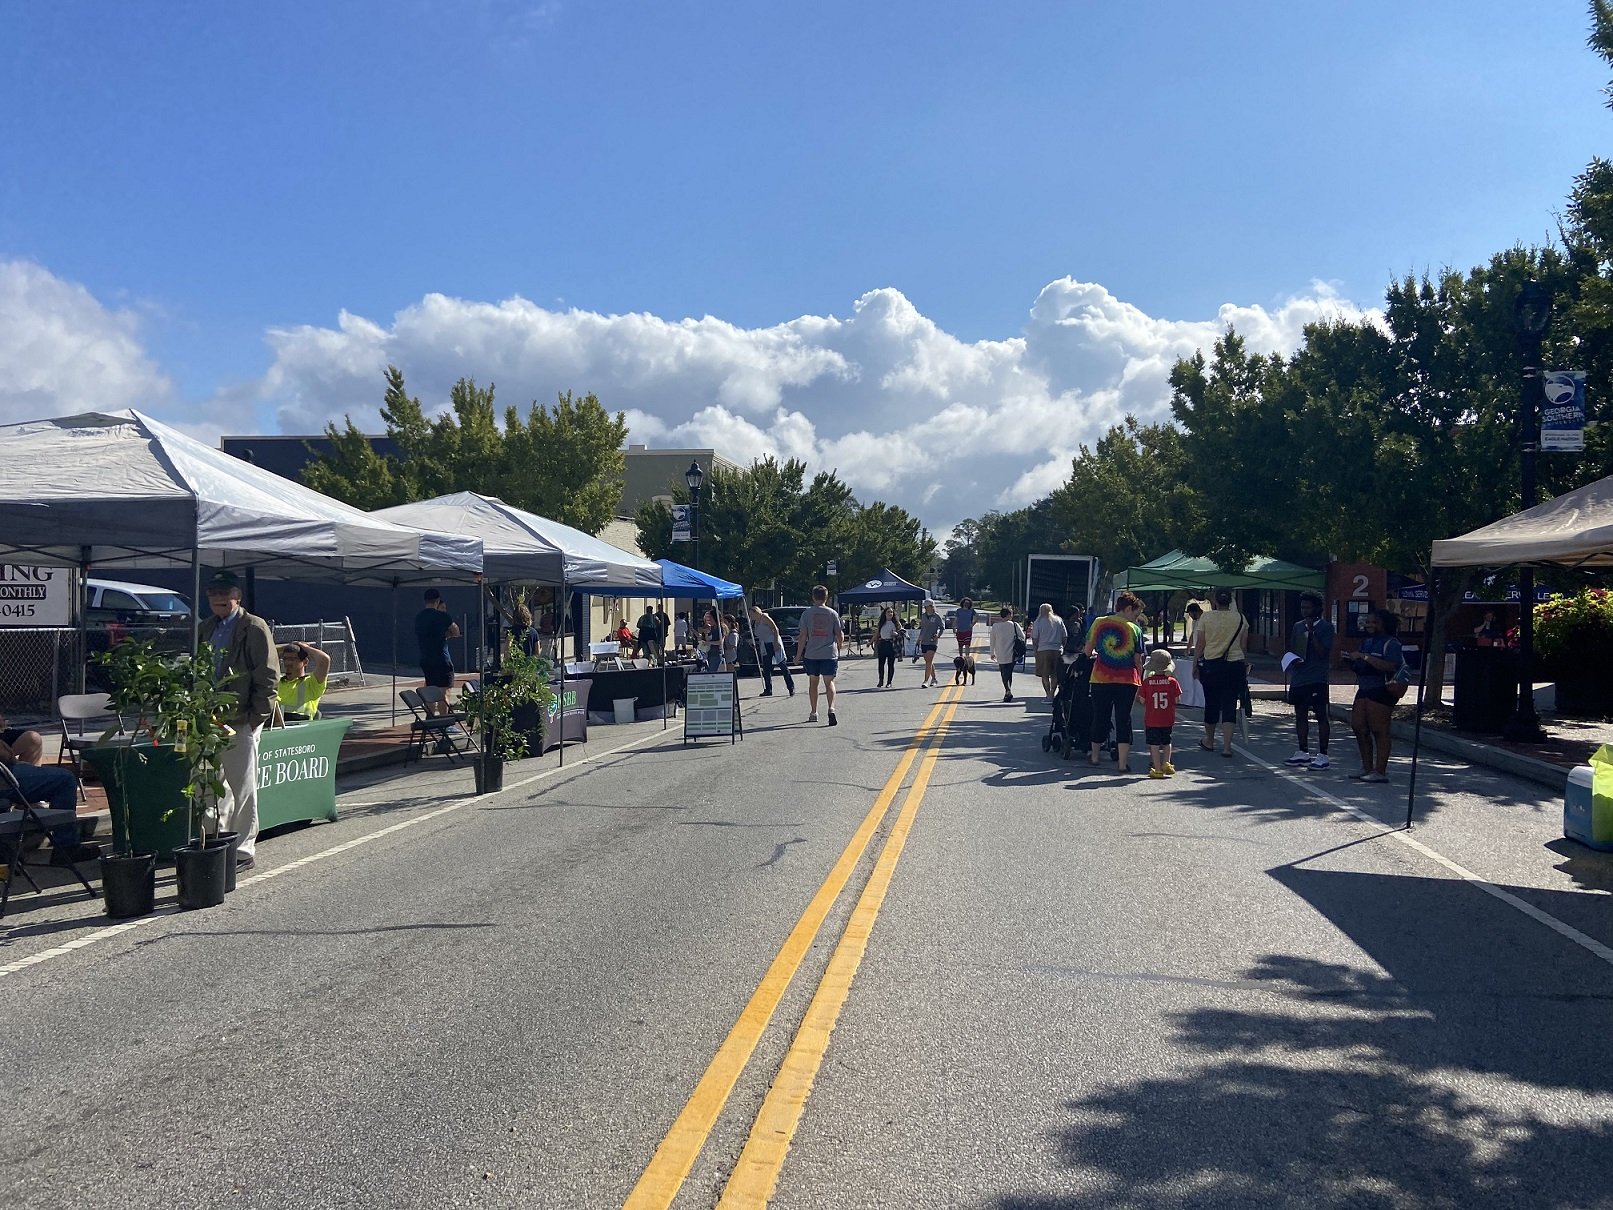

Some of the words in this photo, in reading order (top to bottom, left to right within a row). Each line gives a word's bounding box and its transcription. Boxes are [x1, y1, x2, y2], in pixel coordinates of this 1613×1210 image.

[1542, 412, 1585, 422] SOUTHERN
[1544, 406, 1581, 415] GEORGIA
[1352, 575, 1369, 597] 2
[1152, 692, 1168, 709] 15
[262, 750, 273, 761] OF
[274, 744, 316, 759] STATESBORO
[275, 756, 329, 785] BOARD
